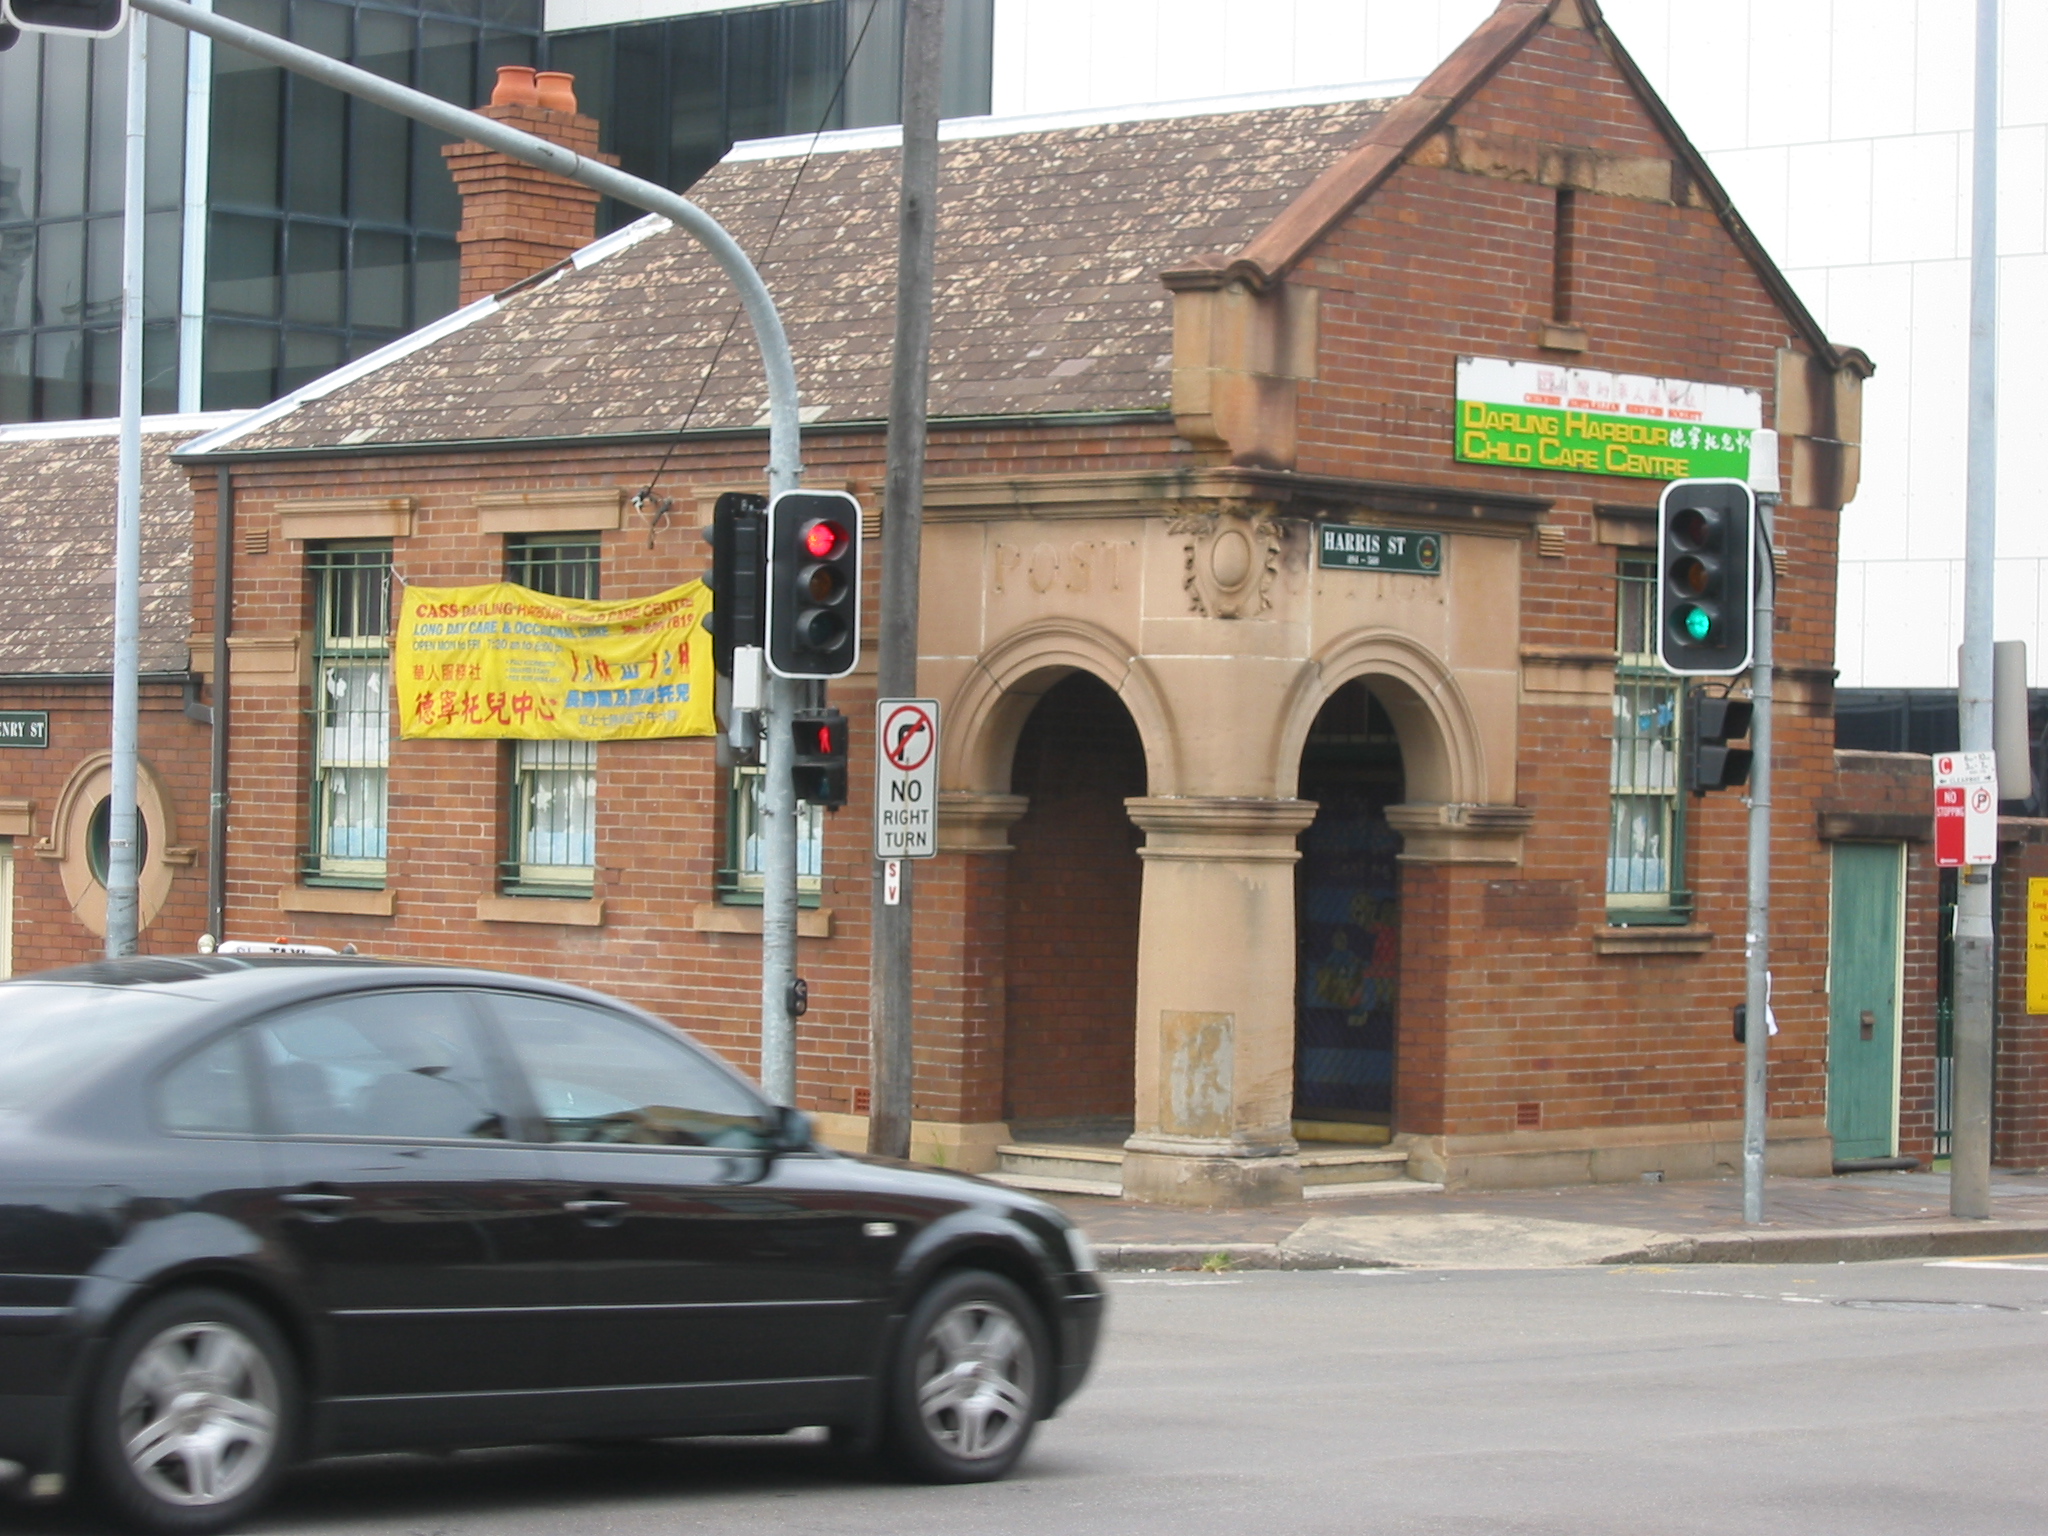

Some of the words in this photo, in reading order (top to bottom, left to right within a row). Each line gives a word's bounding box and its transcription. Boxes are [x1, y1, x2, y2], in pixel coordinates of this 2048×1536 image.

[1464, 401, 1559, 437] DARLING
[1565, 411, 1669, 447] HARBOUR
[1464, 431, 1531, 463] CHILD
[1539, 437, 1600, 470] CARE
[1606, 445, 1690, 477] CENTRE
[1325, 531, 1380, 553] HARRIS
[1387, 536, 1406, 556] ST
[995, 541, 1138, 593] POST
[416, 604, 459, 618] CASS
[643, 597, 693, 617] CENTRE
[413, 623, 443, 636] LONG
[446, 622, 467, 635] DAY
[469, 620, 497, 634] CARE
[502, 621, 511, 634] &
[413, 640, 435, 651] OPEN
[30, 721, 46, 738] ST
[891, 779, 922, 803] NO
[1944, 791, 1958, 804] NO
[883, 809, 929, 826] RIGHT
[1937, 806, 1965, 817] STOPPING
[885, 832, 927, 848] TURN
[889, 862, 896, 877] S
[889, 886, 897, 901] V
